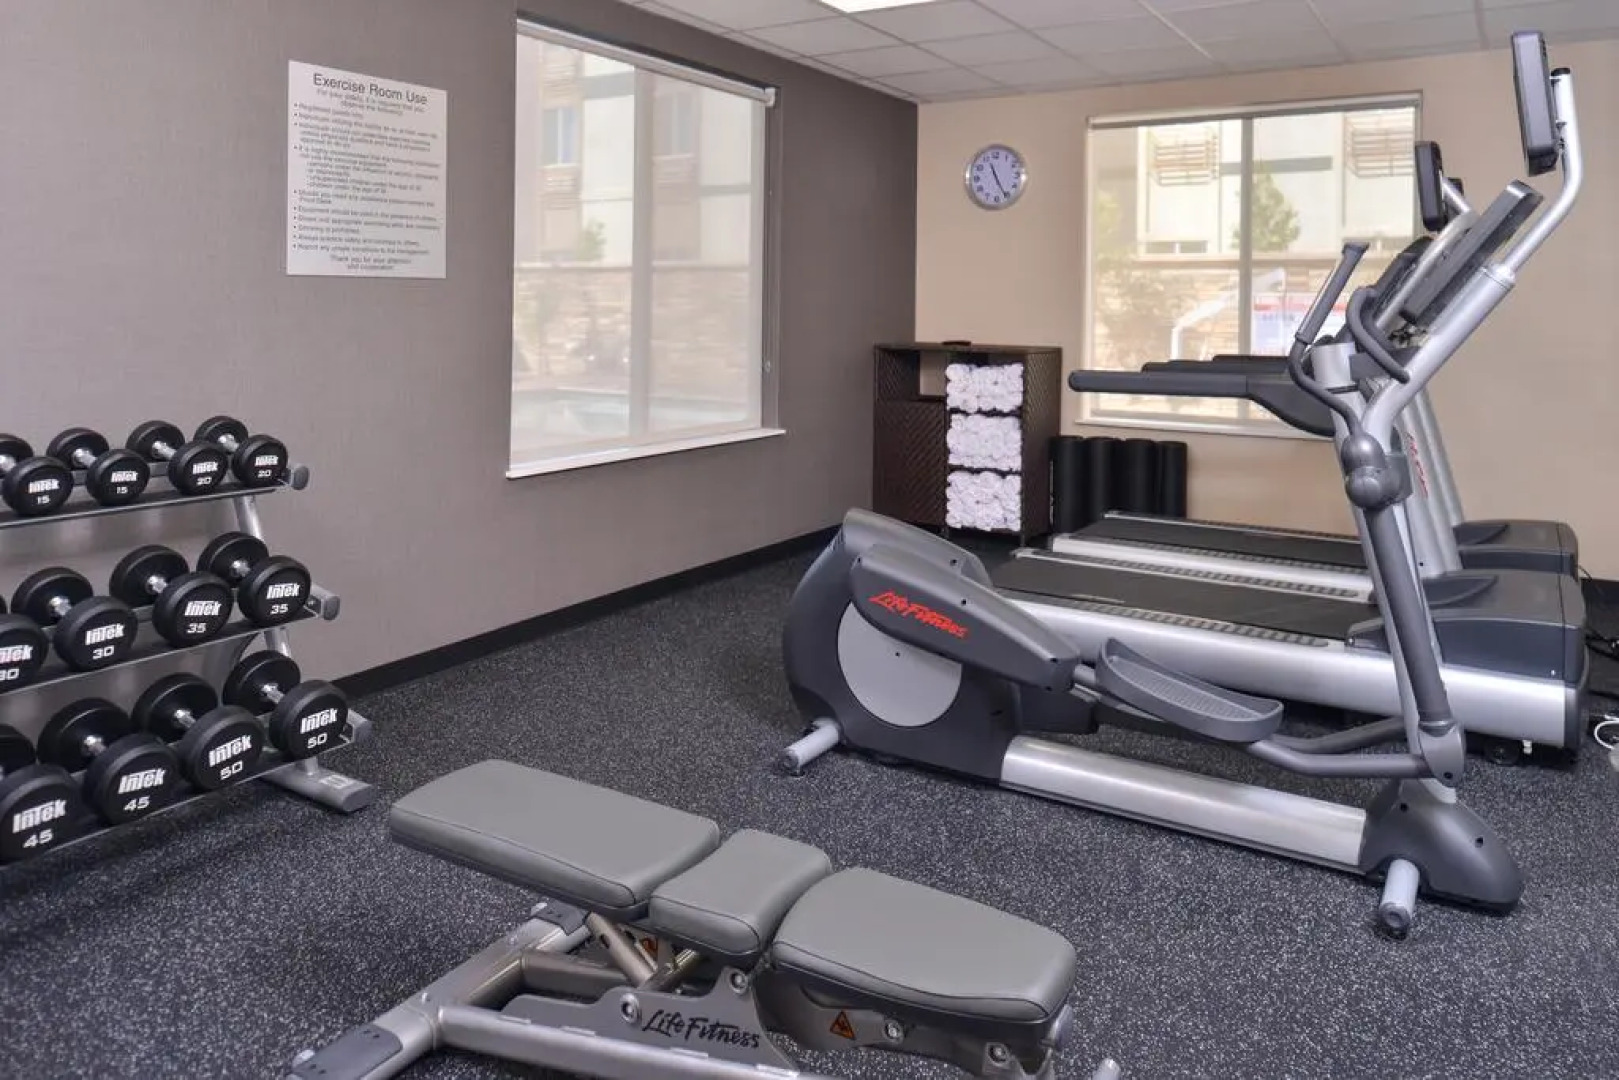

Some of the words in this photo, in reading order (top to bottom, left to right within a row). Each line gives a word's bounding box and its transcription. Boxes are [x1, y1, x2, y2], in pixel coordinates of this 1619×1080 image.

[312, 72, 366, 94] Exercise
[369, 83, 403, 100] Room
[405, 91, 428, 105] Use
[37, 495, 49, 504] 15
[267, 583, 300, 599] InTek
[185, 601, 222, 616] InTek
[271, 604, 289, 614] 35
[85, 623, 124, 646] InTek
[187, 622, 207, 633] 35
[93, 646, 115, 660] 30
[301, 707, 338, 734] InTek
[307, 733, 328, 749] 50
[208, 734, 252, 768] InTek
[220, 761, 244, 780] 50
[118, 768, 166, 795] InTek
[124, 796, 150, 811] 45
[13, 799, 66, 834] InTek
[23, 829, 53, 848] 45
[684, 1016, 760, 1048] Fitness
